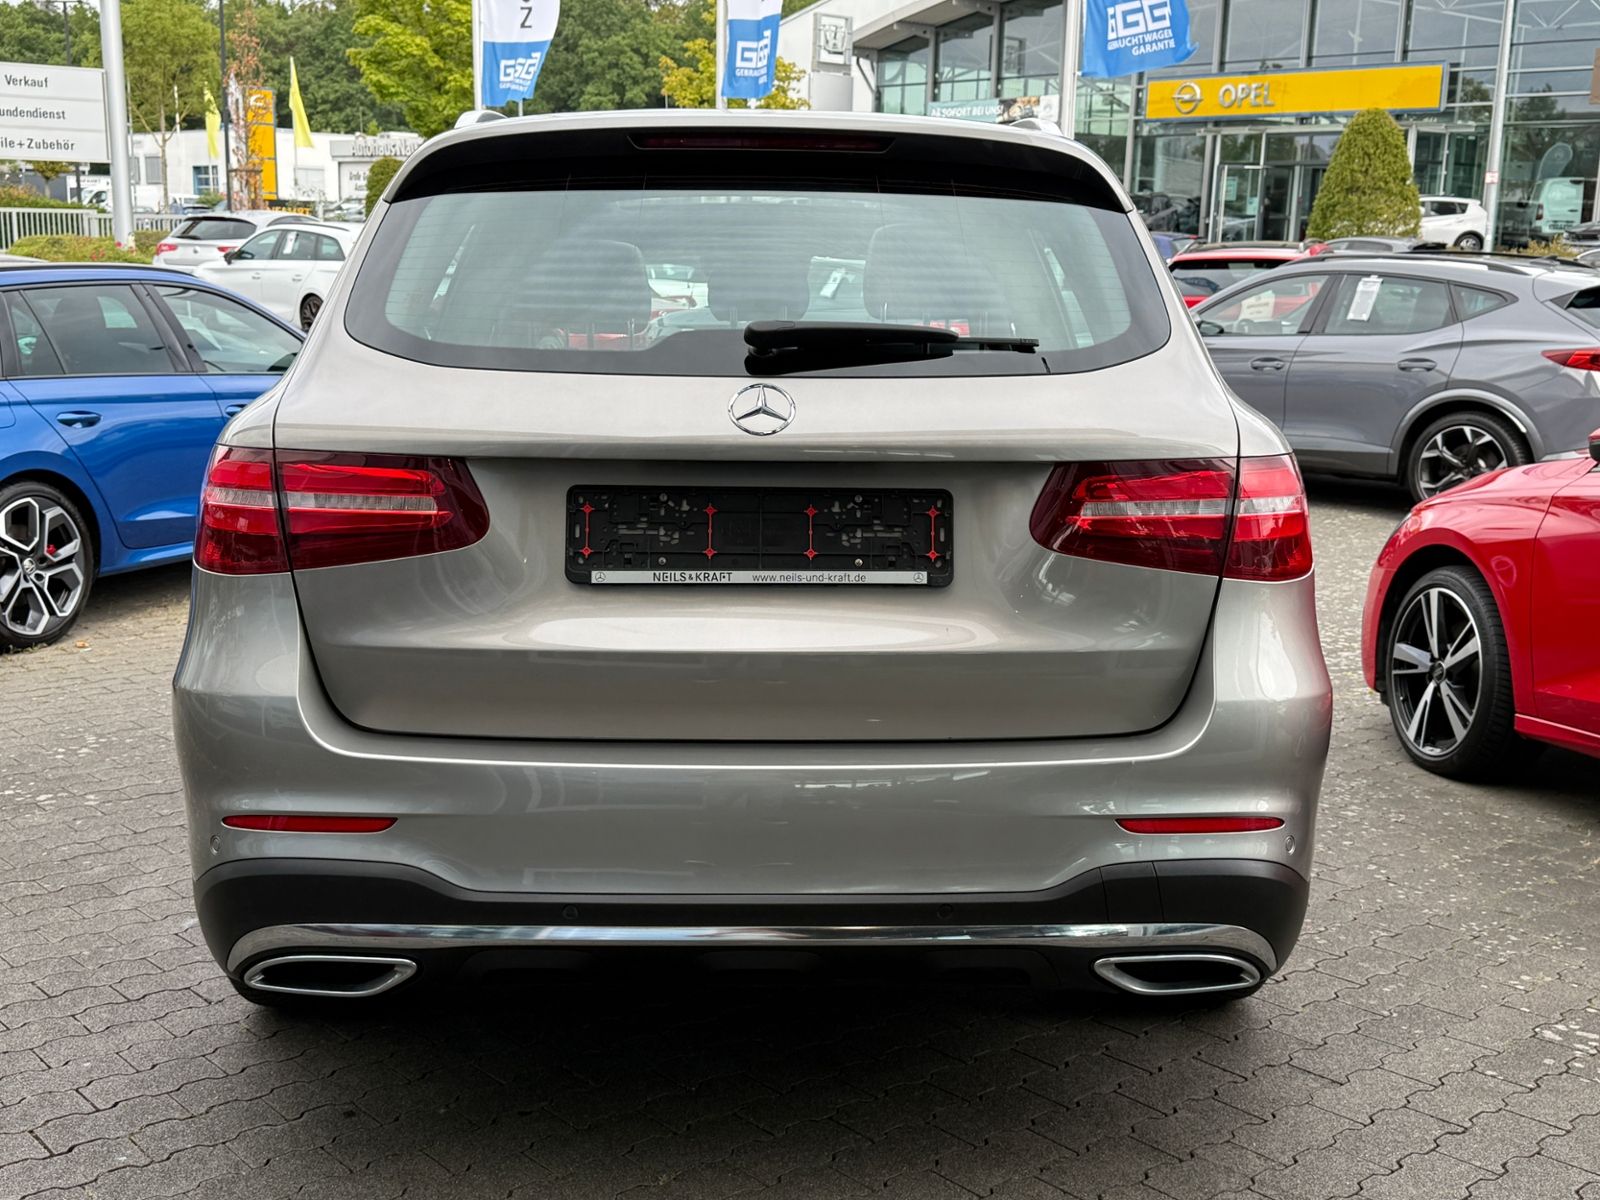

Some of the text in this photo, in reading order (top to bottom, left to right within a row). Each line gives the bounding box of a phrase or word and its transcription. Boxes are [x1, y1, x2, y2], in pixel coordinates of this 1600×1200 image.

[4, 74, 49, 88] Verkauf
[1218, 82, 1275, 108] OPEL
[0, 106, 66, 120] undendienst
[752, 572, 867, 583] www.neils-und-kraft.de
